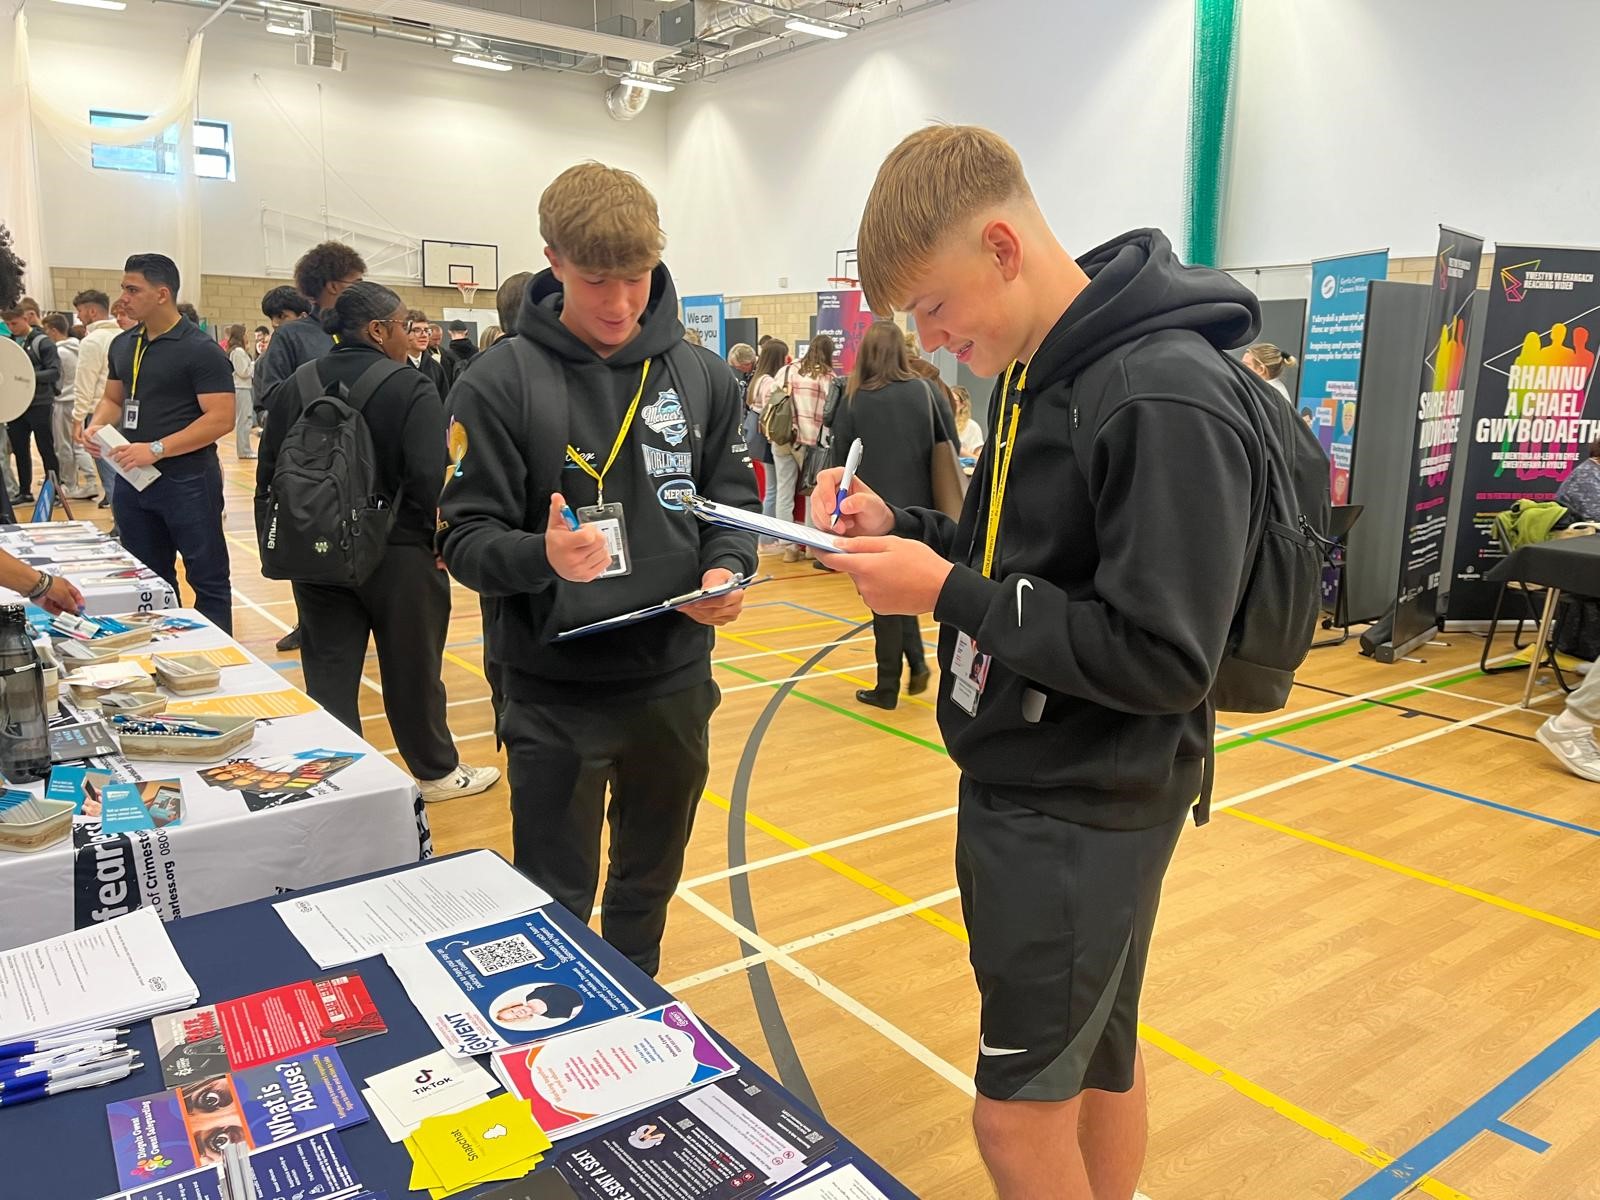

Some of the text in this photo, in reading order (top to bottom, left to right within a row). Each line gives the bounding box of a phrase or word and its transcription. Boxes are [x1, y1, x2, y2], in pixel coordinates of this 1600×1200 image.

[688, 312, 712, 324] We can
[704, 330, 718, 342] you
[1508, 364, 1586, 390] RHANNU
[1504, 392, 1580, 417] A CHAEL
[1475, 418, 1600, 444] GWYBODAETH
[152, 892, 162, 906] of
[445, 958, 458, 968] your
[451, 967, 464, 977] have
[453, 958, 468, 970] Gwent
[462, 980, 475, 991] Scan
[466, 973, 484, 988] policing
[444, 1013, 487, 1051] GWENT
[262, 1083, 280, 1100] is
[274, 1061, 317, 1112] Abuse?
[412, 1077, 453, 1095] TikTok
[142, 1101, 160, 1154] Gwent Safeguarding
[266, 1099, 298, 1142] What
[132, 1117, 147, 1158] Diogelu Gwent
[451, 1128, 479, 1162] Snapchat
[571, 1149, 600, 1171] SEXT
[590, 1166, 607, 1178] A
[594, 1174, 625, 1197] SENT
